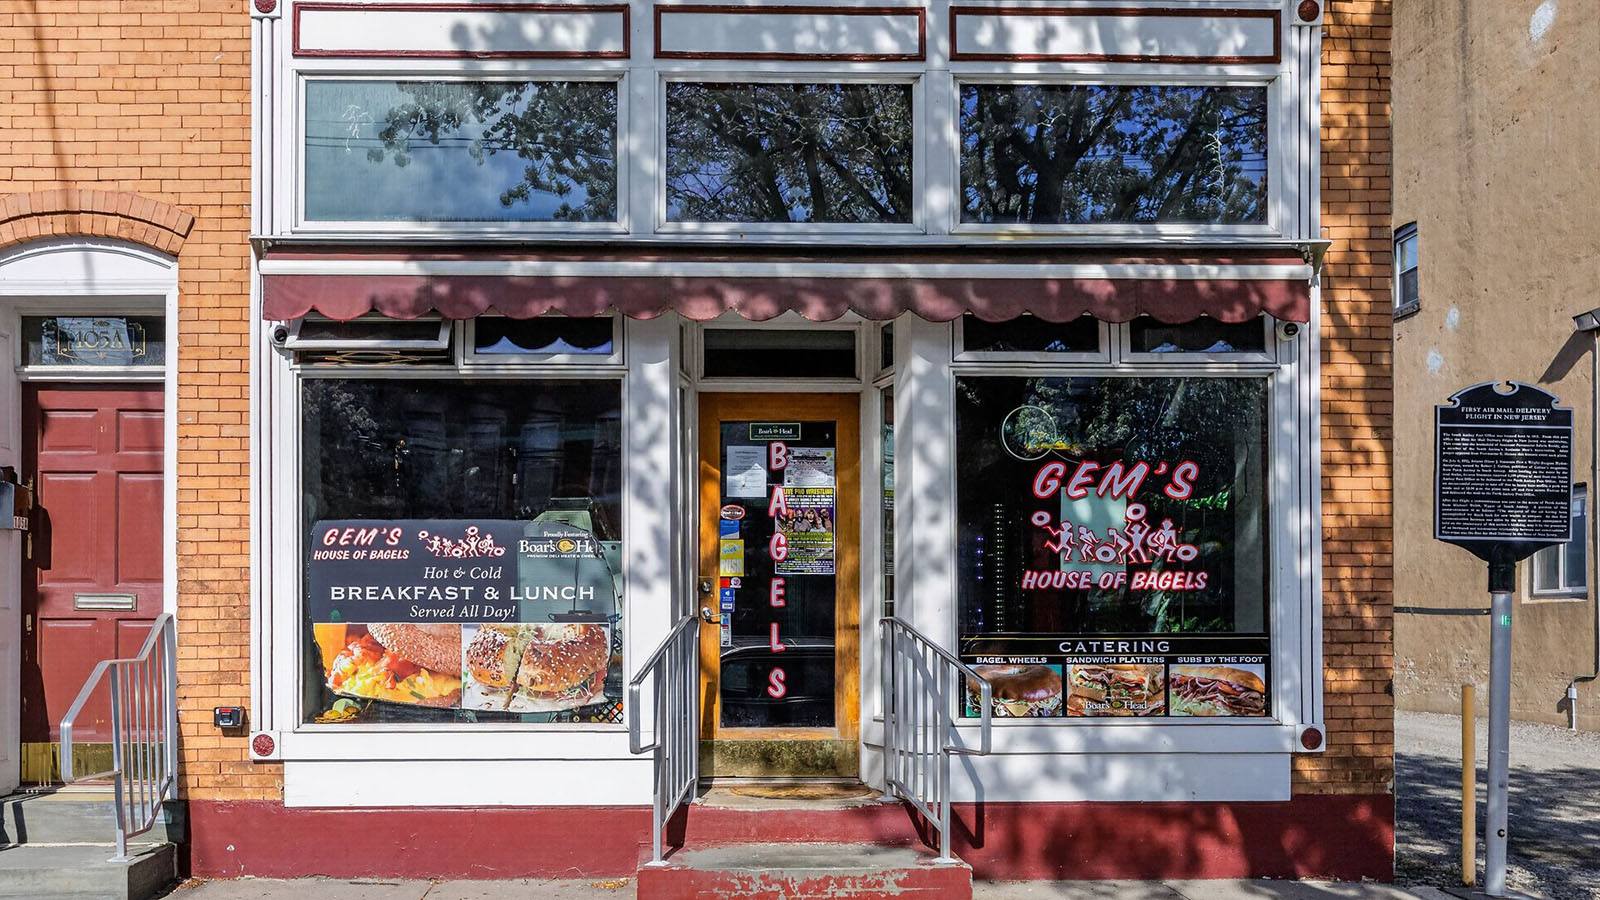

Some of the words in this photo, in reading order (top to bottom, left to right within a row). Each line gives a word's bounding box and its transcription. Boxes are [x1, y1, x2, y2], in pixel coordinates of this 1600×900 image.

[74, 330, 125, 350] 105A
[1032, 460, 1200, 500] GEM'S
[322, 526, 404, 546] GEM'S
[543, 531, 564, 539] Proudly
[519, 540, 556, 553] Boar's
[313, 549, 351, 561] HOUSE
[352, 549, 367, 561] OF
[369, 549, 410, 561] BAGELS
[424, 567, 448, 579] Hot
[454, 567, 466, 579] &
[469, 567, 502, 579] Cold
[767, 441, 787, 699] BAGELS
[1021, 570, 1092, 591] HOUSE
[1098, 570, 1127, 591] OF
[1130, 570, 1208, 591] BAGELS
[330, 586, 474, 601] BREAKFAST
[484, 586, 500, 601] &
[510, 586, 595, 601] LUNCH
[409, 605, 455, 618] Served
[458, 605, 479, 618] All
[482, 605, 516, 621] Day!
[1058, 641, 1170, 653] CATERING
[976, 656, 1007, 664] BAGEL
[1008, 656, 1048, 664] WHEELS
[1066, 656, 1117, 664] SANDWICH
[1118, 656, 1165, 664] PLATTERS
[1177, 656, 1202, 664] SUBS
[1203, 656, 1217, 664] BY
[1218, 656, 1237, 664] THE
[1238, 656, 1264, 664] FOOT
[1085, 700, 1110, 710] Boar's
[1124, 700, 1147, 710] Head
